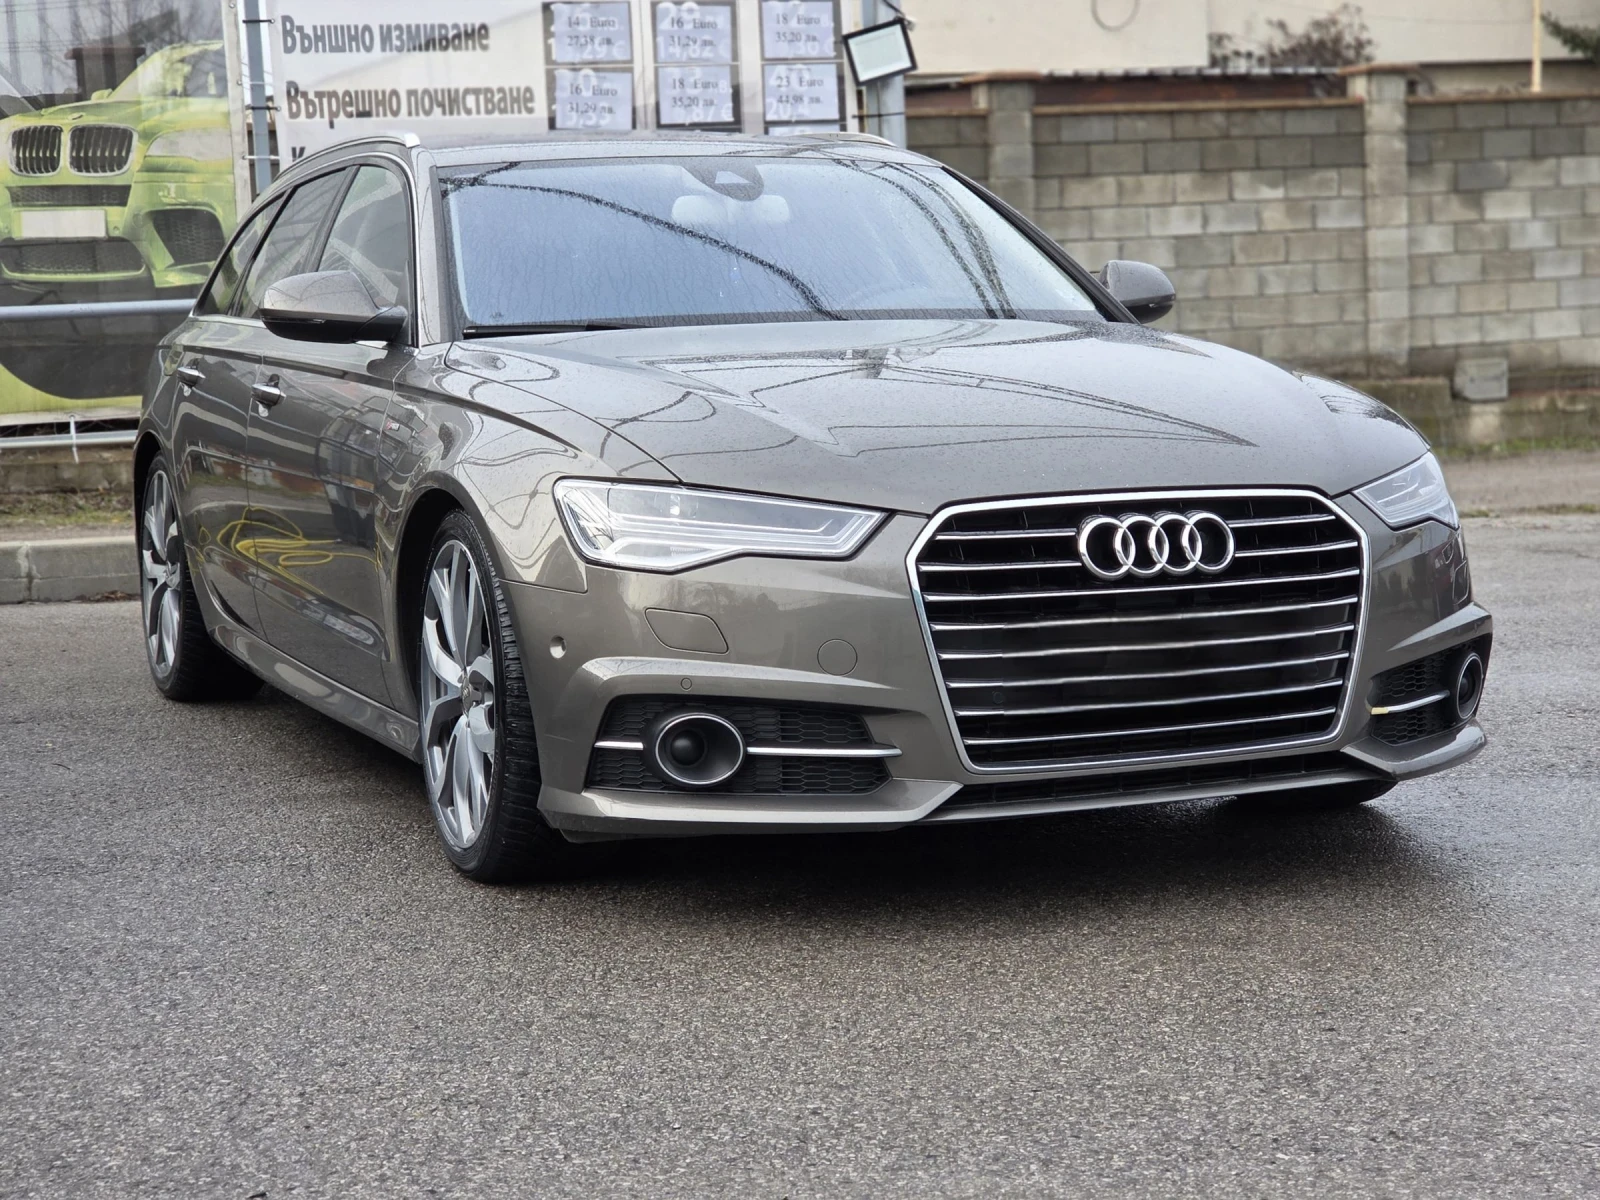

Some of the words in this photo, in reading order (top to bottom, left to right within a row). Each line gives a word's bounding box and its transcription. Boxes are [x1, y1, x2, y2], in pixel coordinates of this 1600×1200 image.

[567, 16, 580, 28] 14
[590, 17, 616, 28] Euro
[671, 16, 685, 29] 16
[692, 18, 718, 29] Euro
[776, 13, 788, 25] 18
[797, 14, 820, 25] Euro
[281, 15, 374, 54] Външно
[379, 22, 490, 53] измиване
[775, 31, 802, 43] 35,20
[669, 35, 697, 47] 31,29
[672, 78, 685, 90] 18
[694, 78, 718, 89] Euro
[776, 76, 790, 88] 23
[799, 76, 824, 87] Euro
[569, 83, 583, 95] 16
[592, 84, 618, 96] Euro
[286, 80, 401, 129] Вътрешно
[406, 86, 535, 117] почистване
[672, 97, 699, 108] 35,20
[777, 94, 804, 106] 44,98
[568, 102, 597, 114] 31,29
